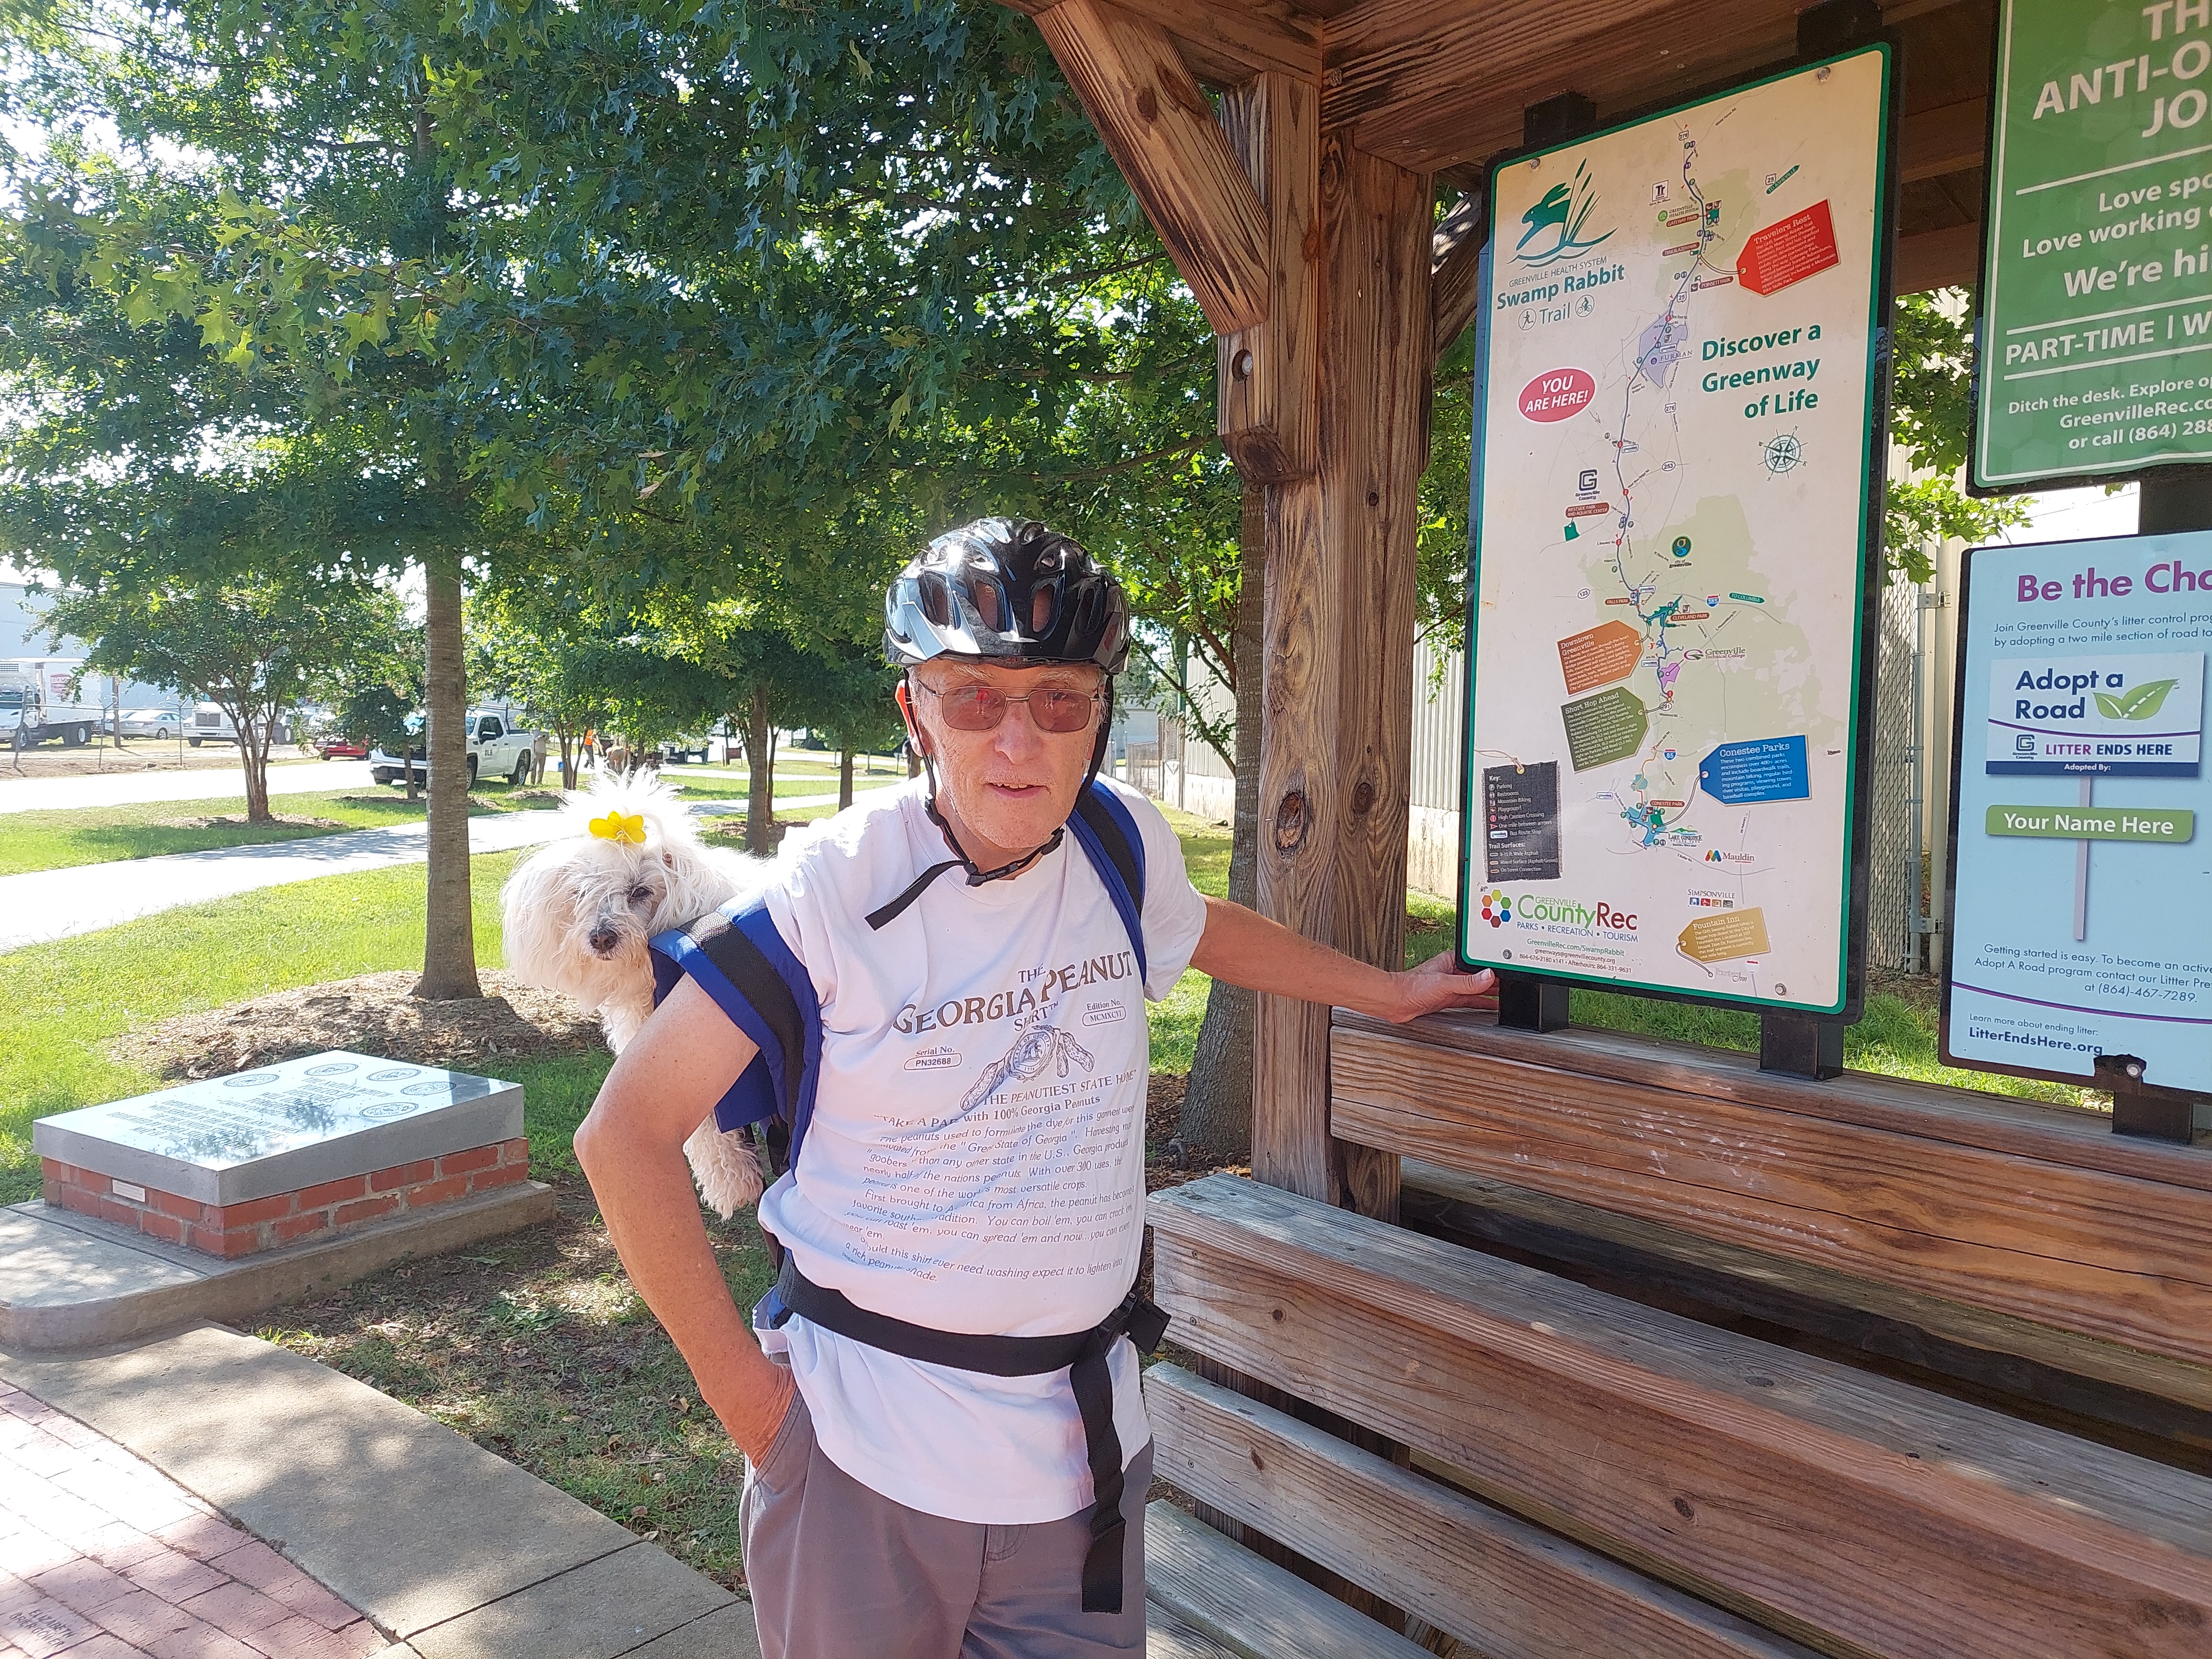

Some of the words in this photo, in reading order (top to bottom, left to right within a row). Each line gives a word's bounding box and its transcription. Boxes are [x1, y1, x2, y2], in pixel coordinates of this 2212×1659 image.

[2142, 89, 2212, 138] JO
[2099, 185, 2162, 212] Love
[1792, 214, 1811, 228] Rest
[2023, 233, 2082, 258] Love
[2089, 207, 2201, 243] working
[1509, 271, 1548, 288] GREENVILLE
[1551, 263, 1577, 278] HEALTH
[1579, 256, 1607, 271] SYSTEM
[2063, 260, 2163, 298] We're
[2173, 244, 2212, 278] hi
[1496, 282, 1559, 310] Swamp
[1564, 264, 1625, 294] Rabbit
[1539, 302, 1571, 325] Trail
[1702, 327, 1802, 361] Discover
[1807, 324, 1822, 341] a
[2005, 321, 2156, 366] PART-TIME
[1660, 350, 1693, 361] FURMAN
[1542, 375, 1574, 395] YOU
[1702, 358, 1821, 392] Greenway
[1525, 397, 1550, 413] ARE
[1551, 389, 1589, 408] HERE!
[1744, 395, 1770, 419] of
[1774, 388, 1818, 414] Life
[2008, 397, 2048, 414] Ditch
[2053, 395, 2079, 408] the
[2082, 387, 2125, 404] desk.
[2129, 379, 2194, 398] Explore
[2059, 398, 2212, 429] GreenvilleRec.co
[2068, 437, 2089, 450] or
[2092, 429, 2124, 447] call
[2128, 423, 2177, 444] (864)
[2017, 575, 2063, 603] Be
[2072, 567, 2133, 598] the
[1993, 622, 2013, 633] Join
[2017, 619, 2069, 632] Greenville
[2072, 616, 2119, 630] County's
[2122, 616, 2146, 626] litter
[2148, 612, 2187, 624] control
[1560, 633, 1594, 649] Downtown
[1562, 641, 1595, 656] Greenville
[1705, 647, 1746, 655] Greenville
[2014, 668, 2100, 696] Adopt
[2105, 673, 2124, 688] a
[1565, 704, 1583, 714] Short
[1584, 699, 1598, 709] Hop
[1598, 692, 1620, 704] Ahead
[2015, 697, 2086, 719] Road
[1719, 746, 1760, 757] Conestee
[1762, 742, 1790, 752] Parks
[2046, 744, 2092, 755] LITTER
[2096, 744, 2132, 755] ENDS
[2136, 744, 2173, 755] HERE
[2064, 763, 2097, 771] Adopted
[2098, 764, 2112, 772] By:
[2004, 812, 2049, 830] Your
[2054, 814, 2116, 832] Name
[2122, 816, 2174, 835] Here
[1722, 852, 1755, 862] Mauldin
[1535, 896, 1577, 907] GREENVILLE
[1687, 888, 1736, 899] SIMPSONVILLE
[1517, 921, 1538, 931] PARKS
[1547, 925, 1593, 938] RECREATION
[1602, 931, 1638, 943] TOURISM
[1692, 919, 1726, 930] Fountain
[1527, 938, 1625, 956] GreenvilleRec.com/SwampRabbit
[1534, 949, 1615, 964] greenways@greenvillecounty.org
[1984, 943, 2021, 958] Getting
[2023, 947, 2057, 960] started
[2060, 950, 2069, 960] is
[2071, 952, 2098, 965] easy.
[2101, 954, 2114, 965] To
[2116, 955, 2161, 969] become
[2164, 962, 2179, 971] an
[1018, 962, 1046, 984] THE
[1596, 964, 1632, 973] 864-331-9631
[1974, 957, 2005, 970] Adopt
[2007, 960, 2016, 969] A
[2018, 961, 2045, 973] Road
[2047, 965, 2092, 977] program
[2095, 970, 2135, 982] contact
[2138, 974, 2157, 983] our
[2193, 977, 2212, 989] Pre
[893, 987, 1038, 1034] GEORGIA
[1040, 951, 1132, 1003] PEANUT
[2084, 983, 2096, 992] at
[2098, 983, 2198, 1003] (864)-467-7289.
[1087, 1002, 1109, 1011] Edition
[1110, 999, 1121, 1007] No.
[1089, 1010, 1122, 1023] MCMXCVI
[1969, 1013, 1992, 1024] Learn
[1994, 1017, 2015, 1026] more
[2017, 1018, 2043, 1029] about
[2044, 1023, 2075, 1035] ending
[2077, 1024, 2099, 1037] litter:
[915, 1048, 937, 1057] Serial
[939, 1046, 955, 1054] No.
[1969, 1027, 2103, 1056] LitterEndsHere.org
[916, 1057, 951, 1067] PN32688
[1010, 1083, 1077, 1104] PEANUTIEST
[1080, 1076, 1113, 1092] STATE
[891, 1248, 909, 1259] this
[911, 1252, 932, 1265] shirt
[933, 1259, 956, 1269] ever
[956, 1264, 984, 1275] need
[987, 1267, 1030, 1280] washing
[1032, 1266, 1064, 1279] expect
[1067, 1266, 1073, 1275] it
[1075, 1266, 1084, 1274] to
[1086, 1261, 1111, 1275] lighten
[1112, 1257, 1123, 1268] into
